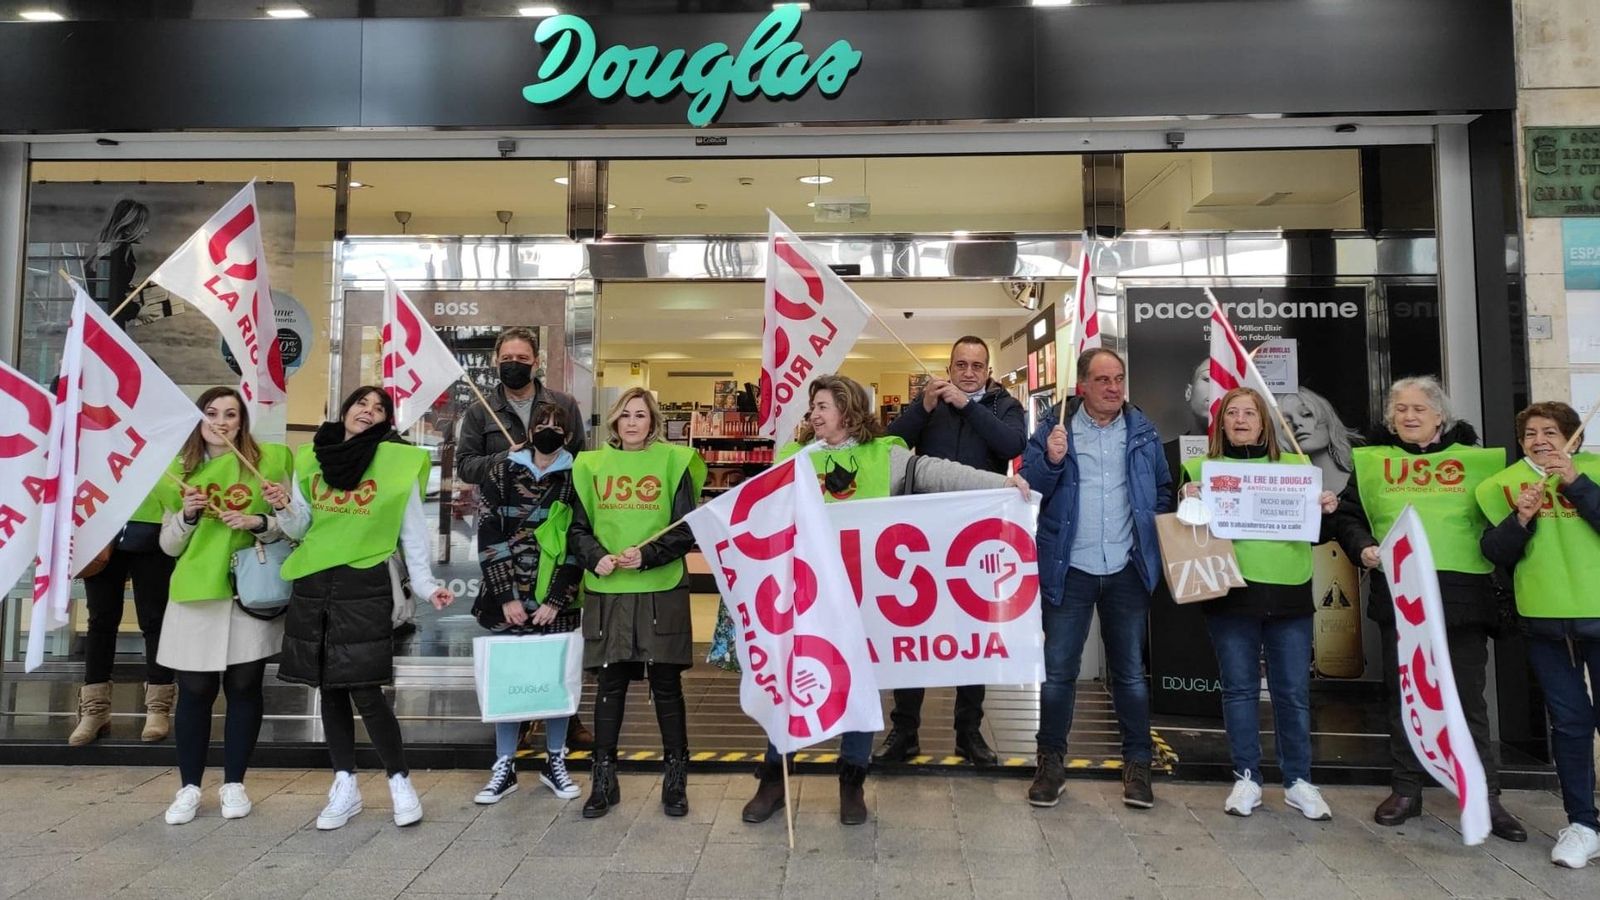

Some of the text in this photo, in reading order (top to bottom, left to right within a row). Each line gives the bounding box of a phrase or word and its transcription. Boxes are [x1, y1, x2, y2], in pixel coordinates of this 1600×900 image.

[522, 4, 862, 127] Douglas
[1534, 186, 1582, 201] GRAN
[434, 303, 479, 315] BOSS
[1135, 298, 1358, 322] paco rabanne
[1239, 324, 1263, 332] Million
[1264, 324, 1282, 332] Elixir
[1186, 446, 1205, 455] 50%
[1269, 476, 1278, 485] DE
[1280, 476, 1312, 485] DOUGLAS
[1384, 458, 1465, 486] USO
[593, 475, 662, 502] USO
[1168, 552, 1248, 598] ZARA
[893, 632, 1010, 663] RIOJA
[509, 684, 549, 694] DOUGLAS
